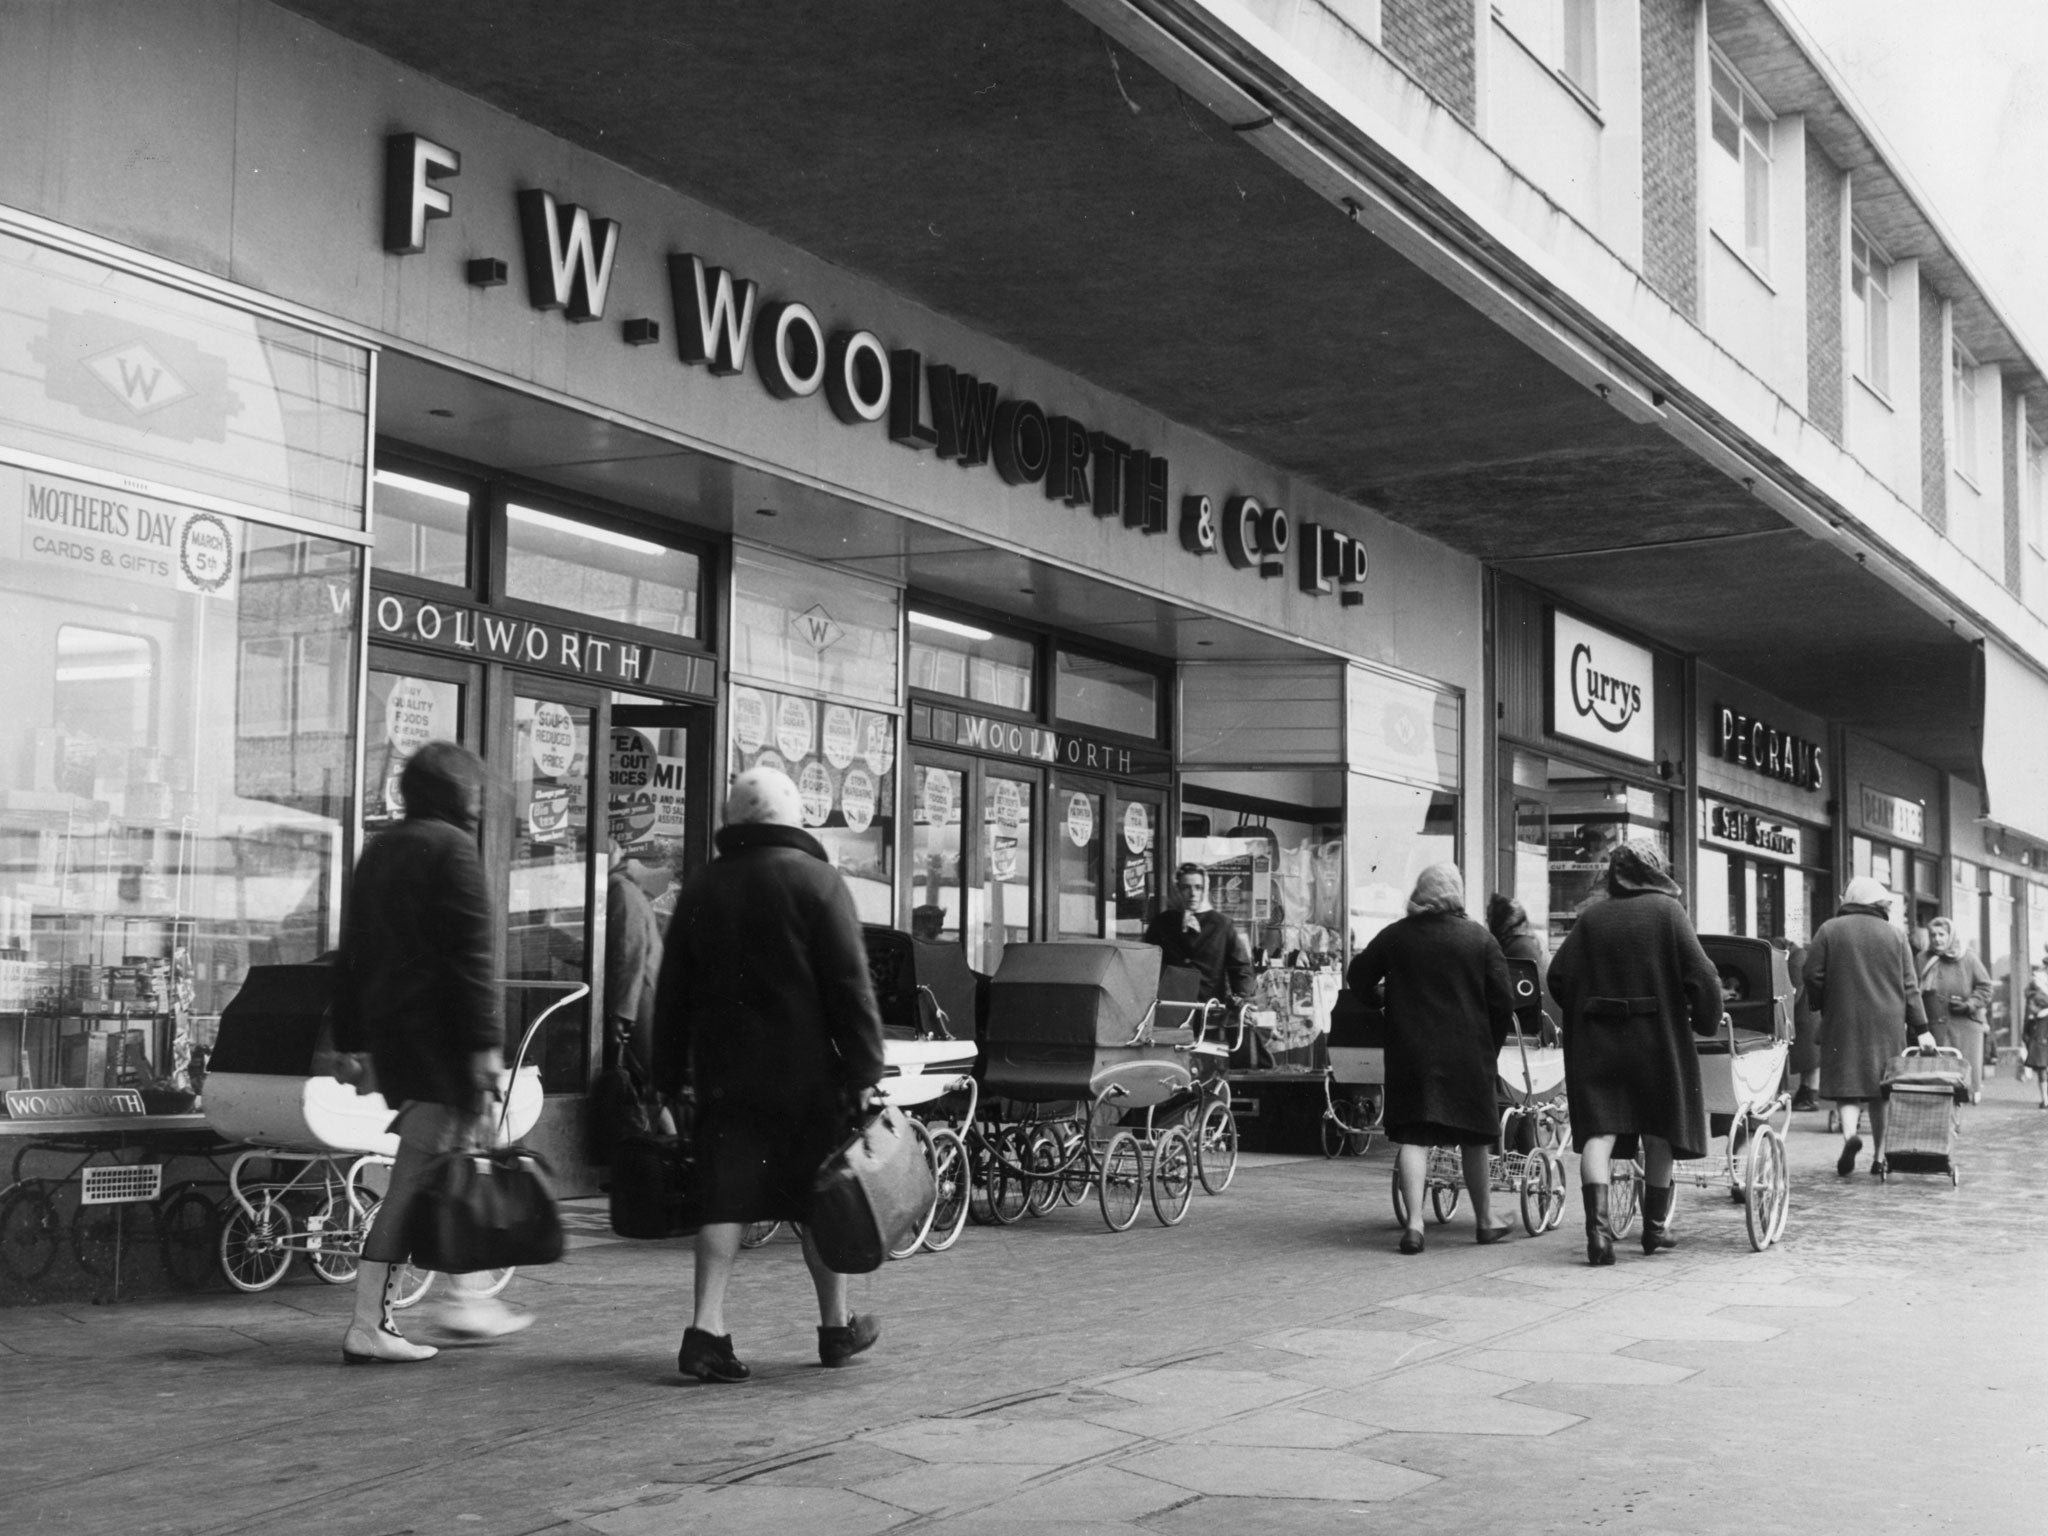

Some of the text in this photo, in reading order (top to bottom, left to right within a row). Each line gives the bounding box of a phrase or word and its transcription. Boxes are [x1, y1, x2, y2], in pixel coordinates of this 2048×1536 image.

[116, 357, 162, 403] W
[668, 252, 1168, 535] WOOLWORTH
[1182, 494, 1217, 556] &
[27, 483, 176, 547] MOTHER'S DAY
[190, 530, 224, 552] MARCH
[32, 536, 169, 577] CARDS & GIFTS
[196, 553, 217, 572] 5th
[808, 618, 829, 643] W
[1571, 643, 1641, 732] Currys
[538, 711, 570, 731] SOUPS
[535, 729, 572, 747] REDUCED
[965, 716, 1131, 774] WOOLWORTH
[542, 753, 565, 770] PRICE
[620, 755, 649, 769] CUT
[1719, 806, 1749, 841] Self
[10, 1095, 142, 1117] WOOLWORTH
